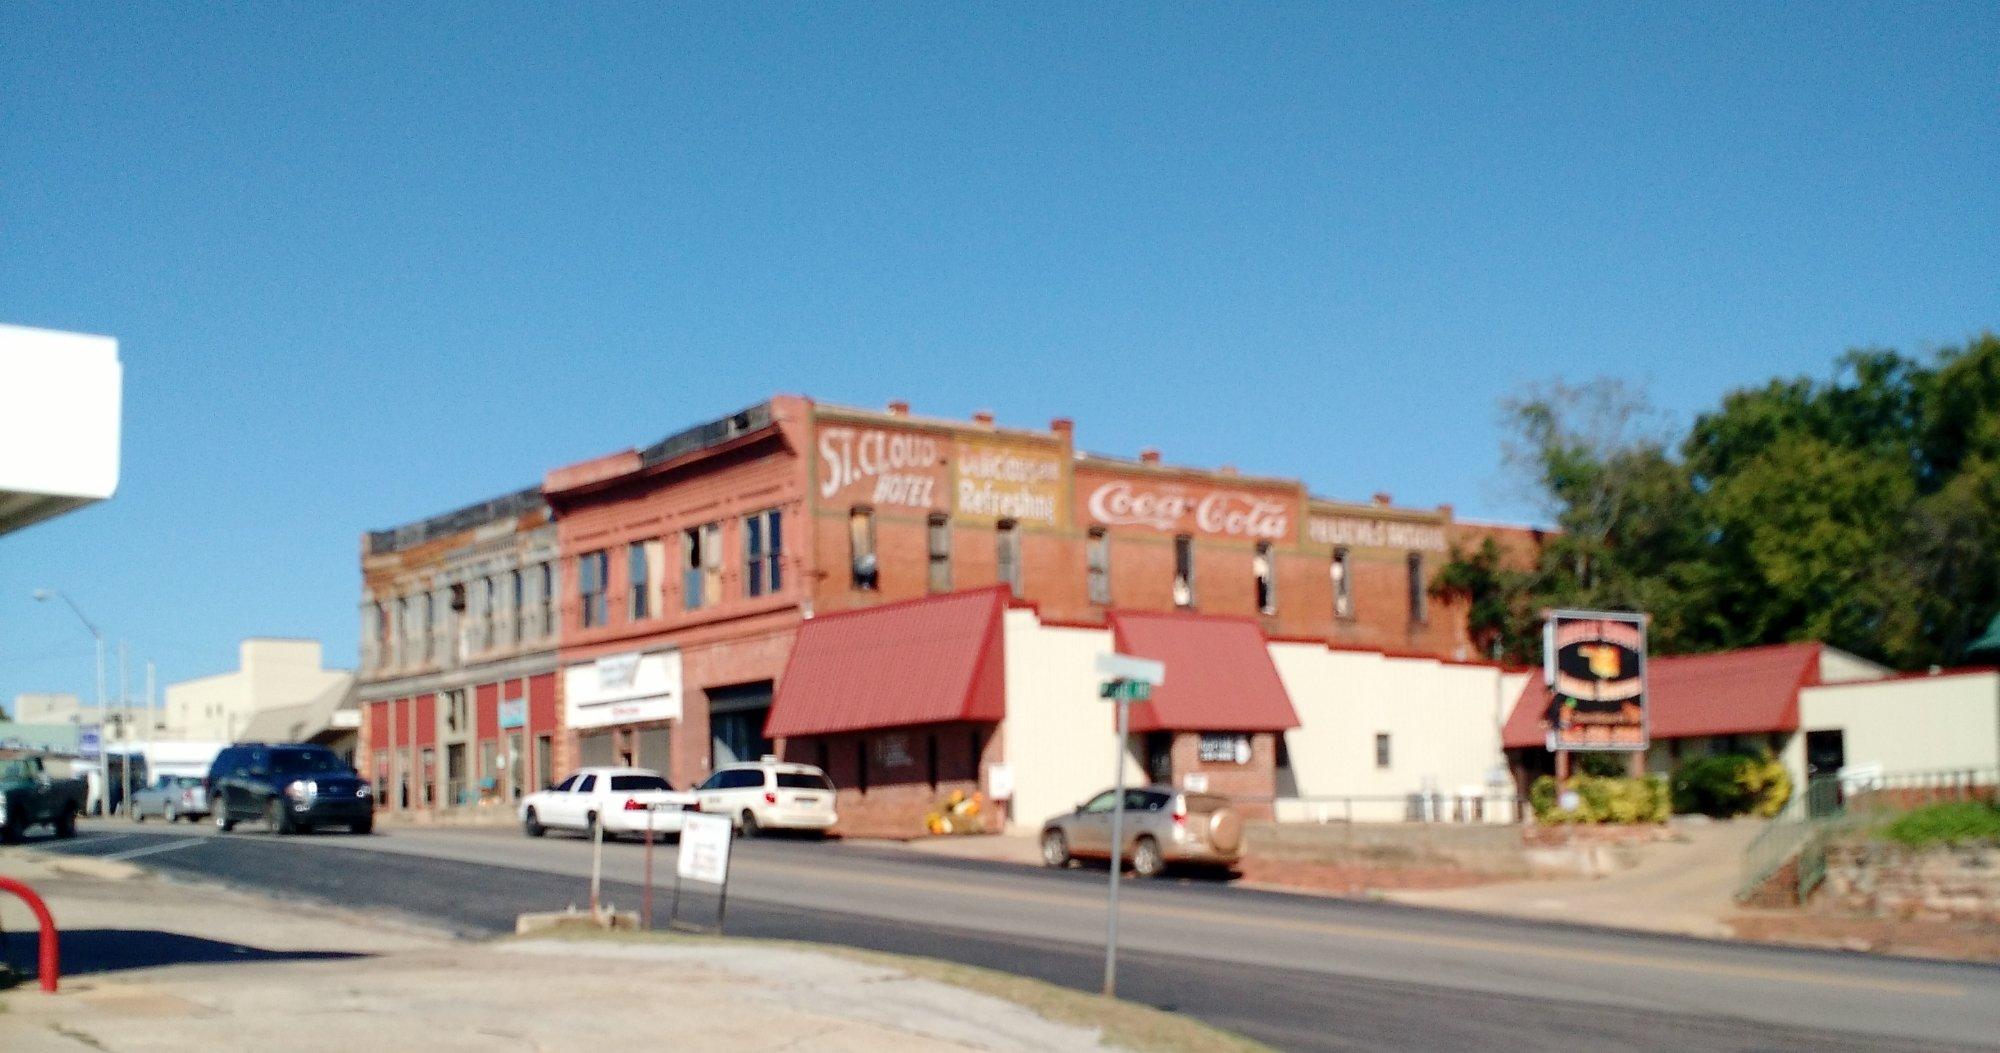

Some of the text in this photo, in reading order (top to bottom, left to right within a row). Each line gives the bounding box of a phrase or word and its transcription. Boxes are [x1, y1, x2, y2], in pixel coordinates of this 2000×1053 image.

[819, 427, 938, 498] ST. CLOUD
[872, 473, 935, 508] HOTEL
